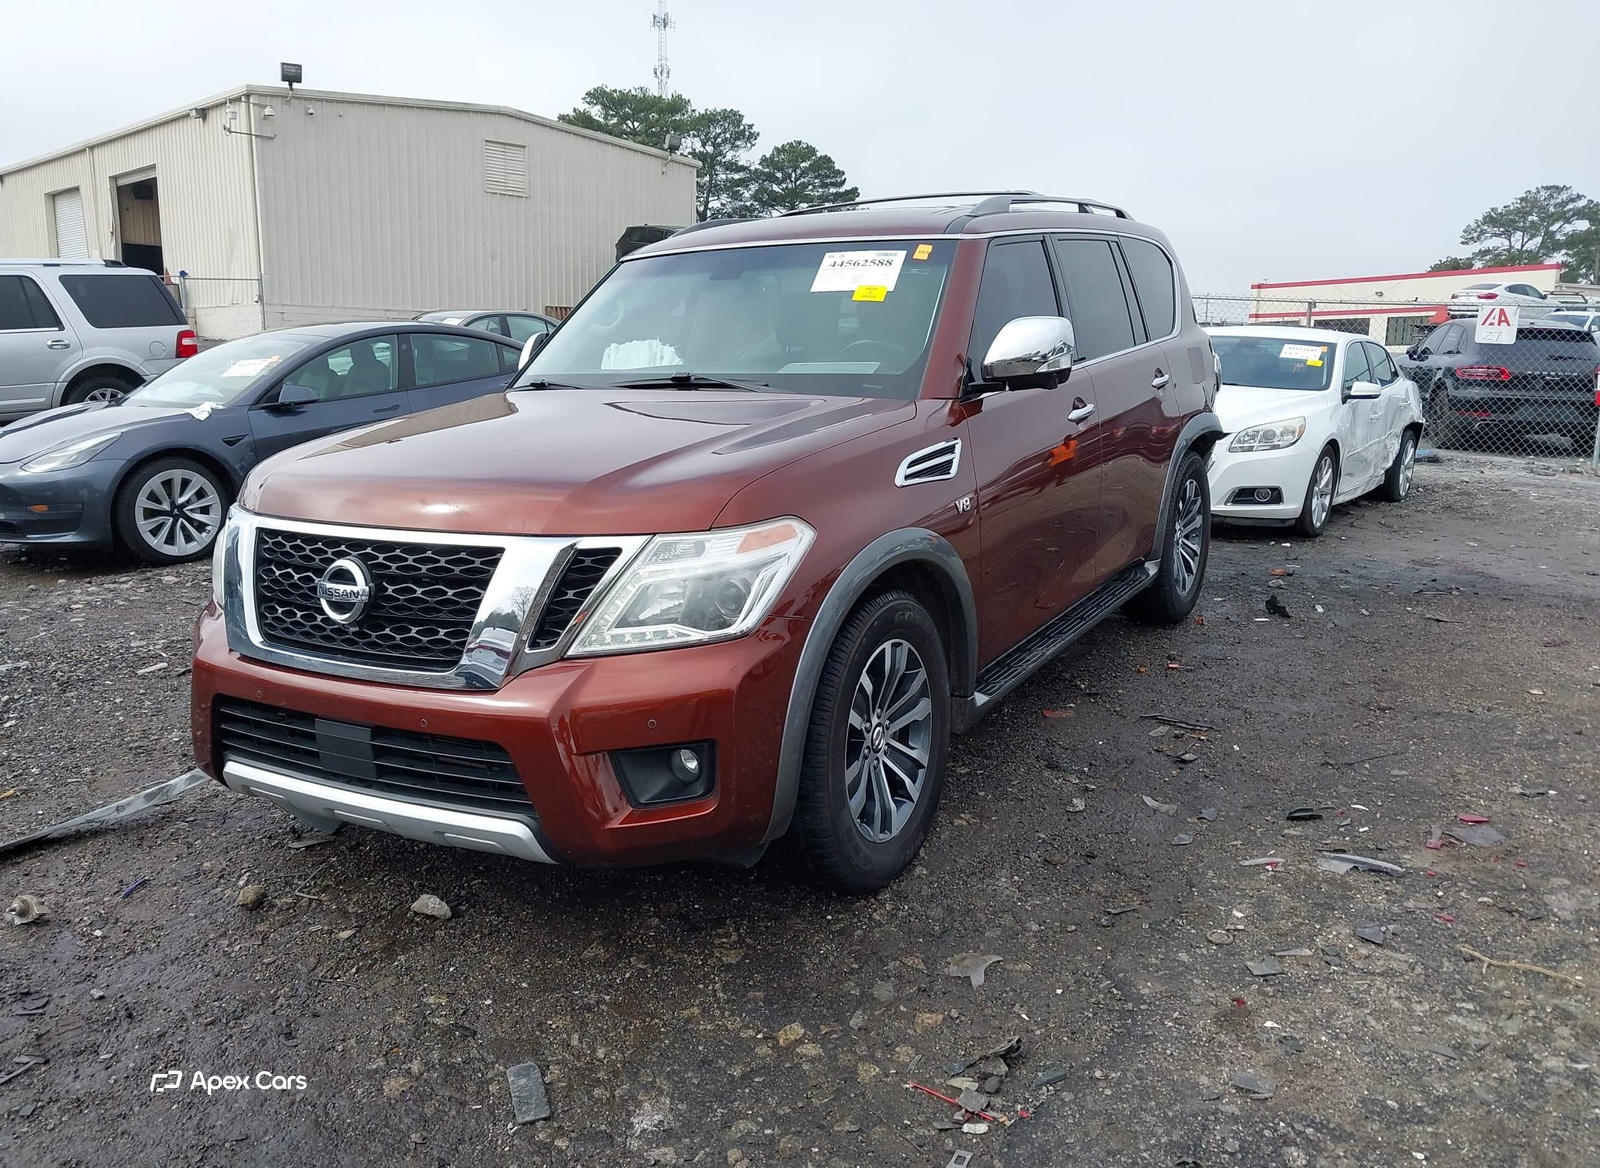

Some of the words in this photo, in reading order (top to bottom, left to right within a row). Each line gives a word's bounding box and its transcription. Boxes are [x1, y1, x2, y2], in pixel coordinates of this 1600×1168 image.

[828, 258, 895, 269] 44562588
[1482, 330, 1502, 342] 27
[954, 497, 971, 514] V8
[318, 582, 360, 599] NISSAN
